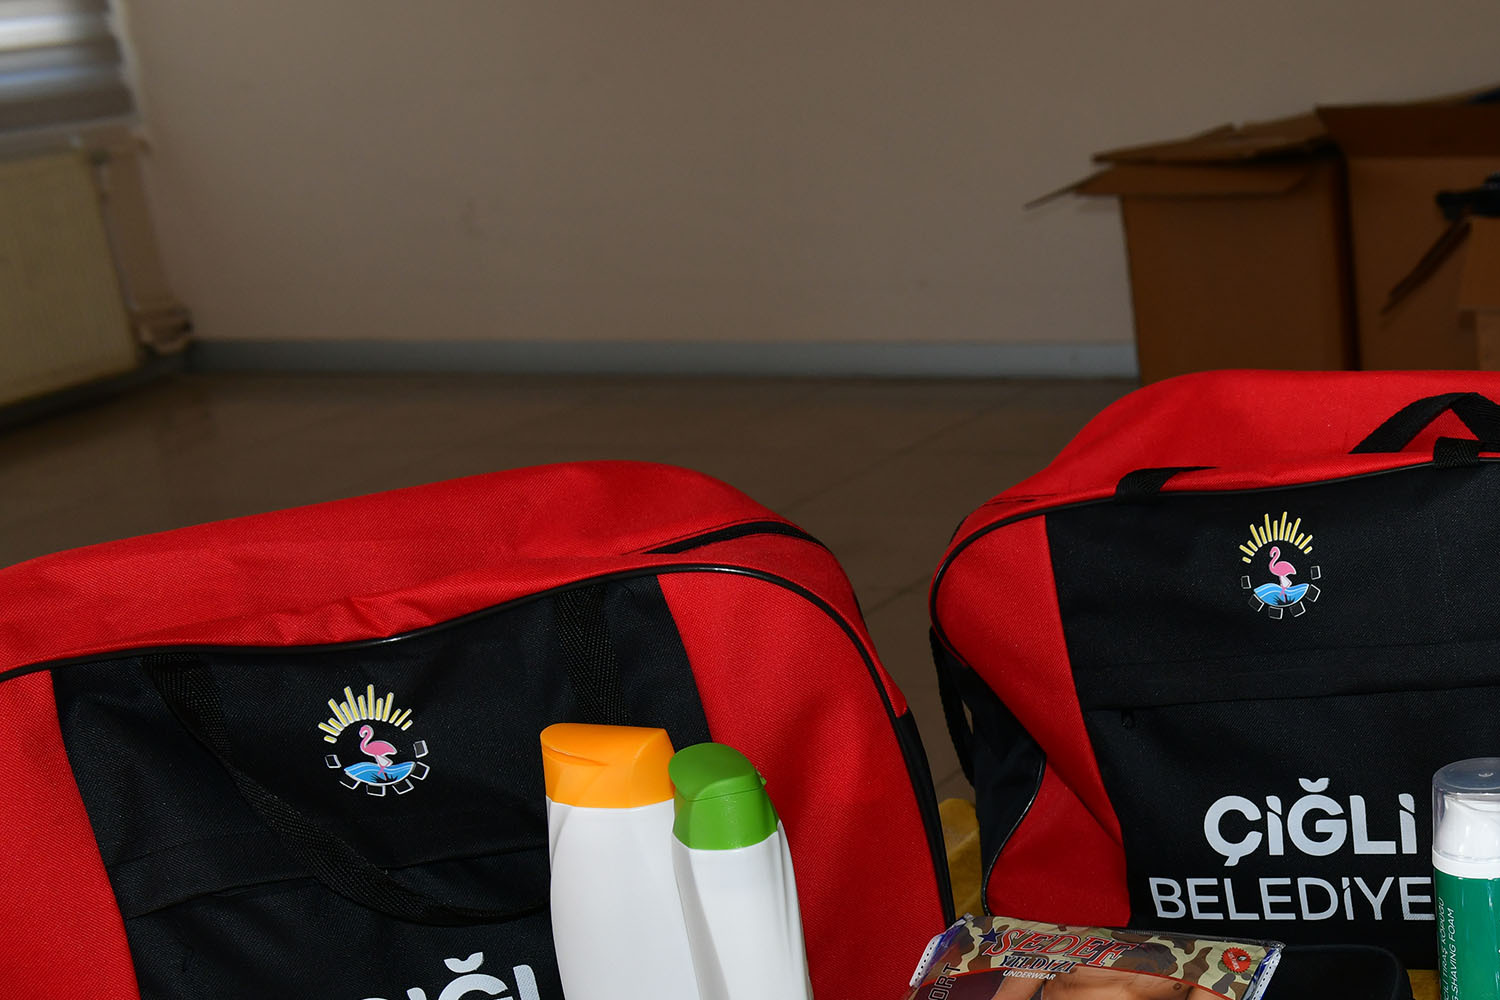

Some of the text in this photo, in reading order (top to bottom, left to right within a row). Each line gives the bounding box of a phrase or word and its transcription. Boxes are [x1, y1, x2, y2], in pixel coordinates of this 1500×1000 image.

[1204, 777, 1417, 866] ÇİĞLİ
[1149, 876, 1435, 921] BELEDİYE
[1447, 907, 1455, 942] FOAM
[982, 929, 1139, 967] SEDEF
[1003, 970, 1057, 980] UNDERWEAR
